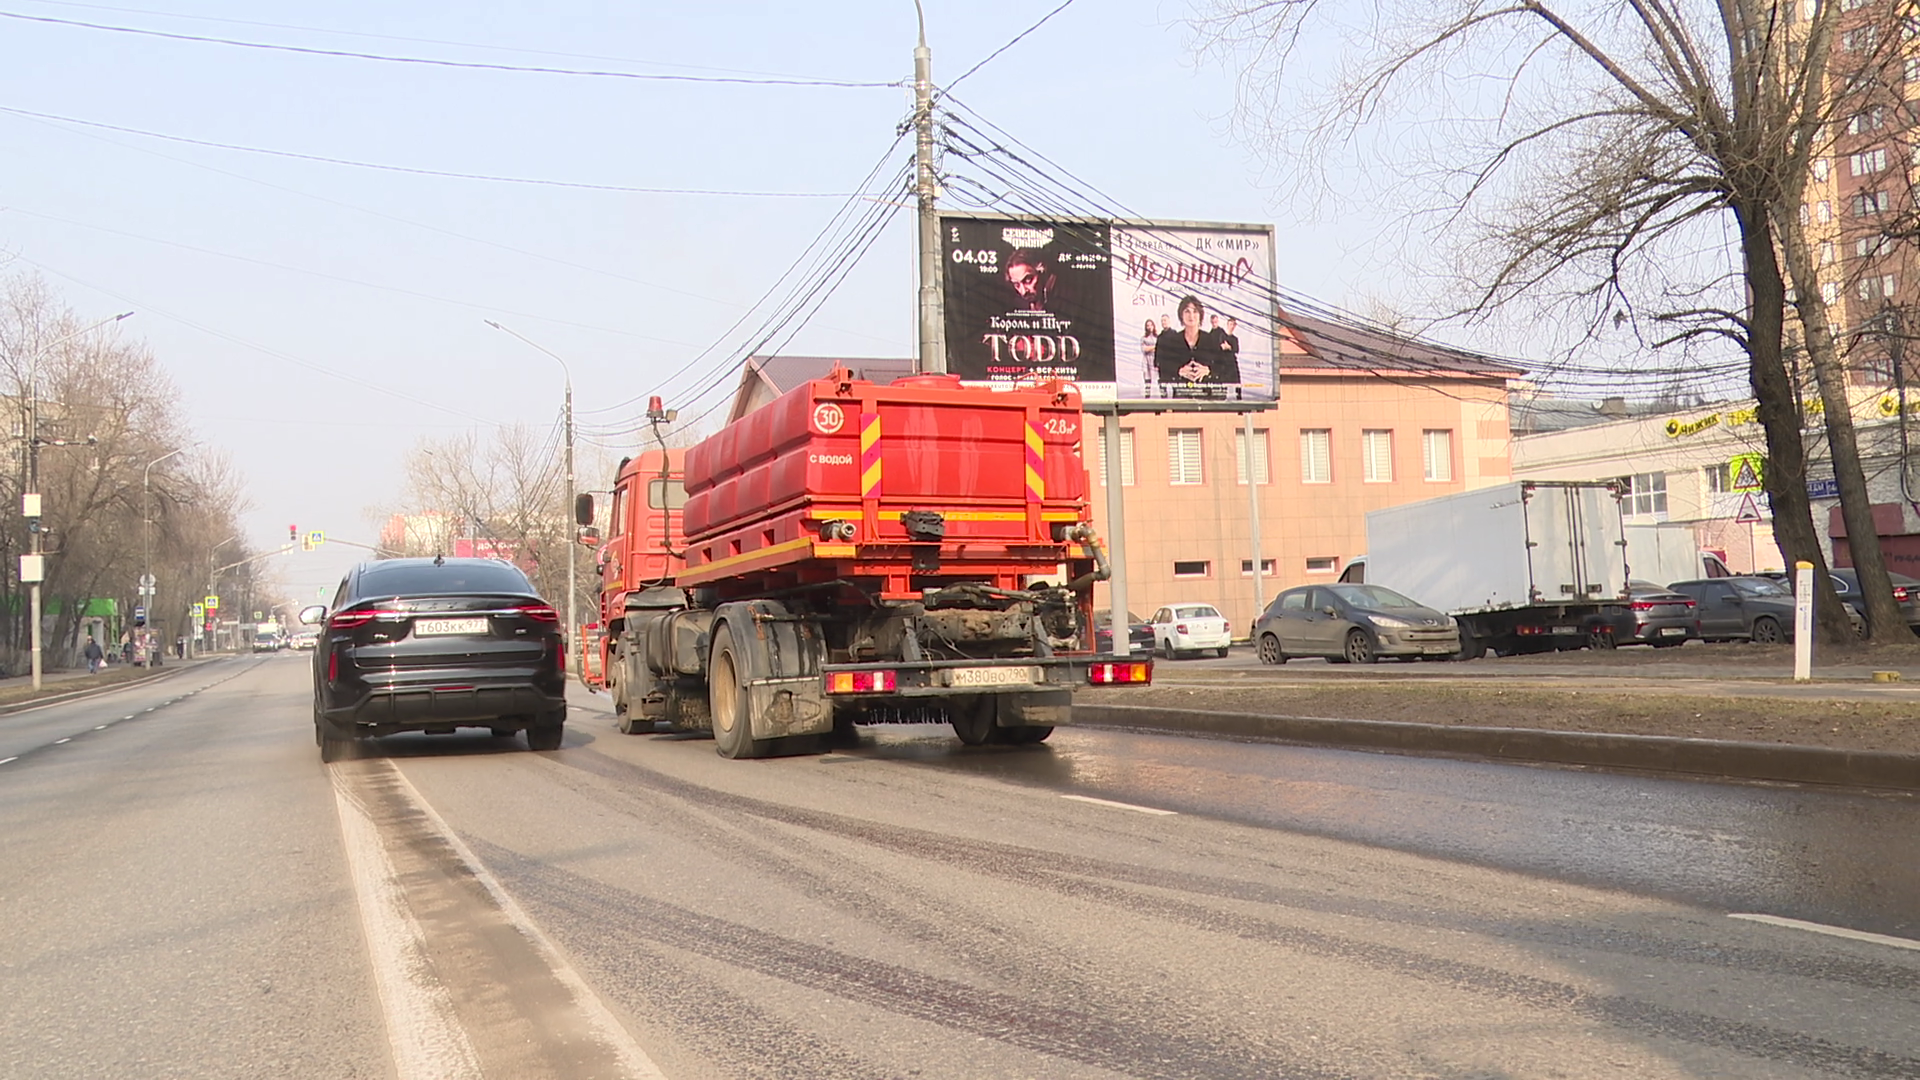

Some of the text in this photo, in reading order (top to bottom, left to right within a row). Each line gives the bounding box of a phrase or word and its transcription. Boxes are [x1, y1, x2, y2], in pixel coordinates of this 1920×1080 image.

[1115, 233, 1133, 249] 13
[1196, 238, 1212, 251] ДК
[1217, 239, 1260, 251] «МИР»
[952, 249, 998, 264] 04.03
[1058, 253, 1072, 262] ДК
[1132, 294, 1146, 305] 25
[990, 316, 1071, 332] Король и Шут
[982, 334, 1081, 362] TODD
[820, 409, 839, 426] 30
[809, 453, 853, 465] С ВОДОЙ
